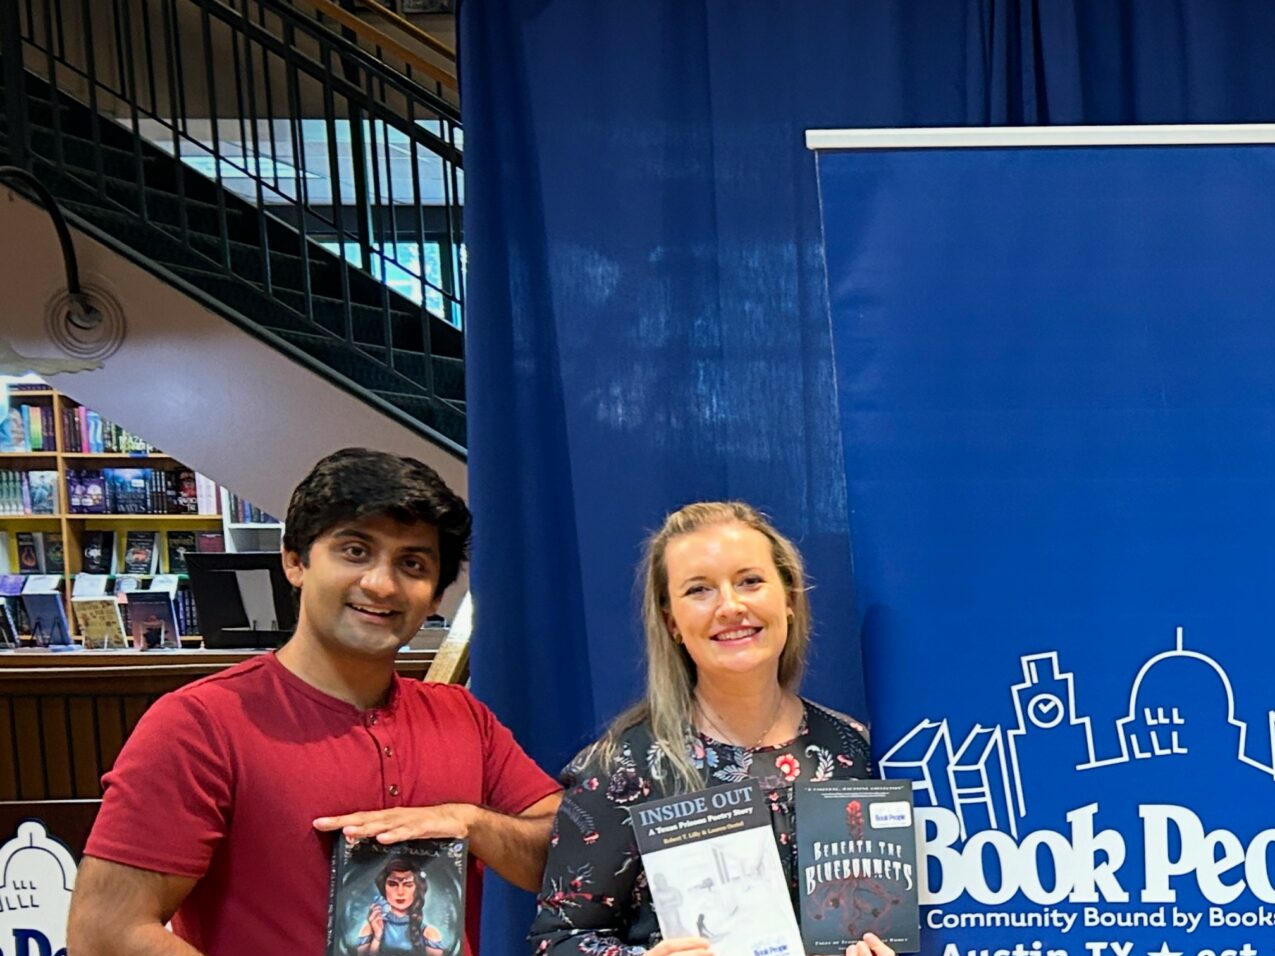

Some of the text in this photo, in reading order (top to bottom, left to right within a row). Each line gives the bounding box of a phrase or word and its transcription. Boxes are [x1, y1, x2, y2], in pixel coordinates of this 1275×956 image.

[638, 786, 753, 826] INSIDE OUT
[732, 806, 754, 818] Story
[813, 840, 902, 861] BENEATH THE
[914, 803, 1129, 905] Book
[805, 857, 913, 896] BLUEBONNETS
[927, 907, 1078, 933] Community
[1084, 907, 1167, 927] Bound
[1172, 907, 1203, 933] by
